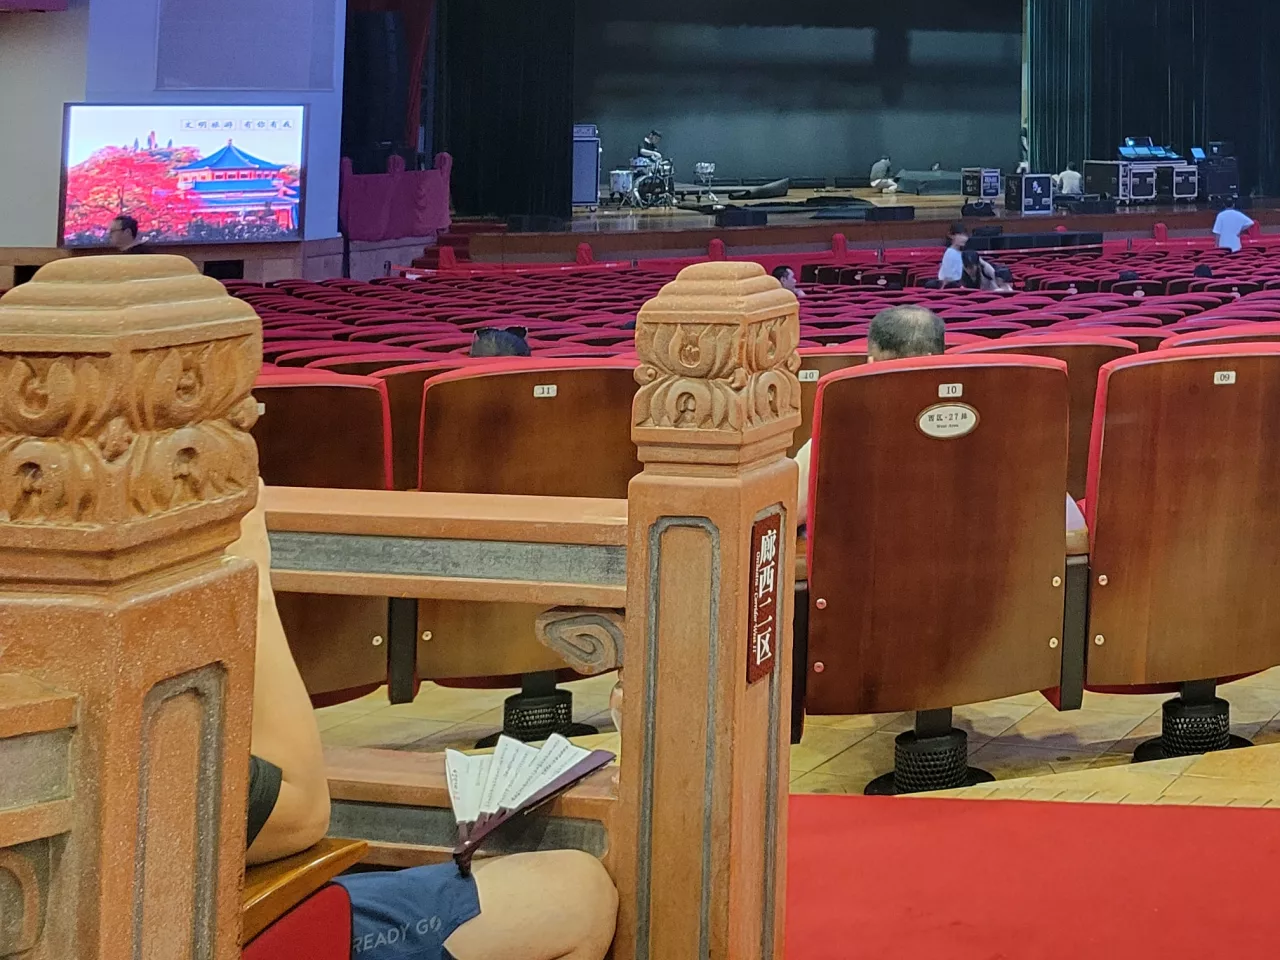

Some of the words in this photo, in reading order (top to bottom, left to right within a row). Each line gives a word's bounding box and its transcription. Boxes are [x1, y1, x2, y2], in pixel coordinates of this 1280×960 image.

[804, 372, 814, 380] 10
[1220, 374, 1230, 382] 09
[946, 386, 957, 395] 10
[757, 528, 777, 666] 廊西二区
[352, 922, 411, 954] READY
